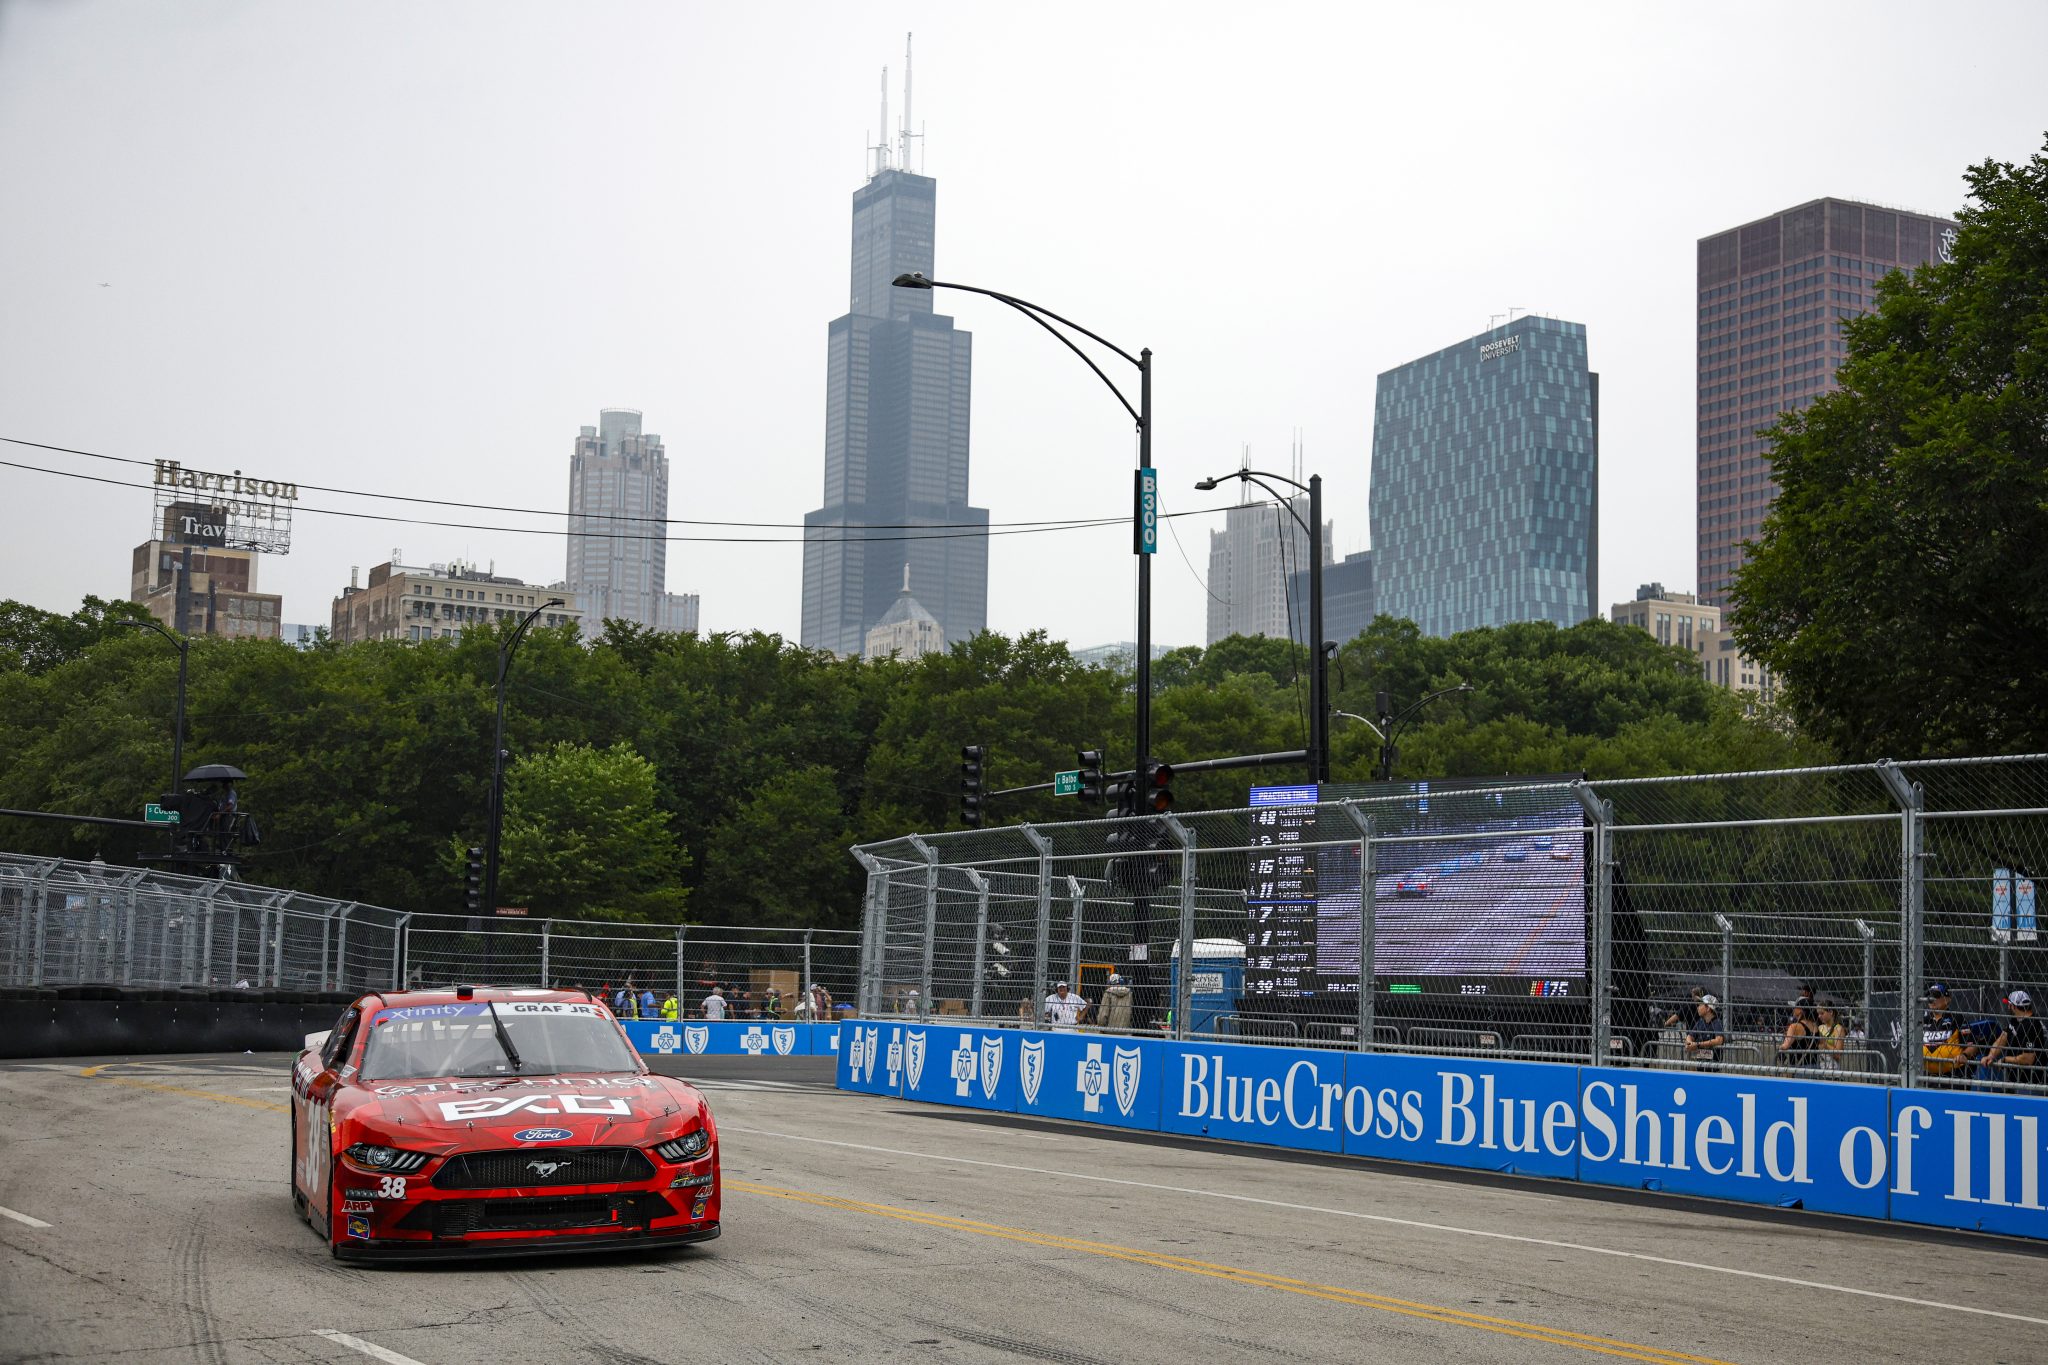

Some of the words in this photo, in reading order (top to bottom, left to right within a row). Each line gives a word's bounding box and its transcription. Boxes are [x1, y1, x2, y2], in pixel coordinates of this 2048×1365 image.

[1480, 335, 1519, 353] ROOSEVELT
[1480, 343, 1520, 362] UNIVERSITY
[153, 458, 299, 501] Harrison
[211, 498, 281, 521] HOTEL
[1143, 476, 1155, 545] B300
[1062, 775, 1077, 784] Balbo
[1258, 791, 1291, 800] PRACTICE
[1294, 790, 1309, 799] TIME
[1259, 810, 1277, 825] 48
[1258, 859, 1276, 874] 16
[1285, 855, 1305, 866] SMITH
[1259, 881, 1274, 898] 11
[1258, 906, 1274, 923] 7
[1550, 981, 1569, 997] 75
[391, 1005, 466, 1020] xfinity
[514, 1004, 563, 1013] GRAF
[570, 1006, 592, 1014] JR
[1178, 1053, 1424, 1143] BlueCross
[1435, 1071, 1814, 1184] BlueShield
[1839, 1105, 1932, 1196] of
[525, 1129, 561, 1140] Ford
[377, 1176, 407, 1199] 38
[343, 1200, 373, 1211] ARP
